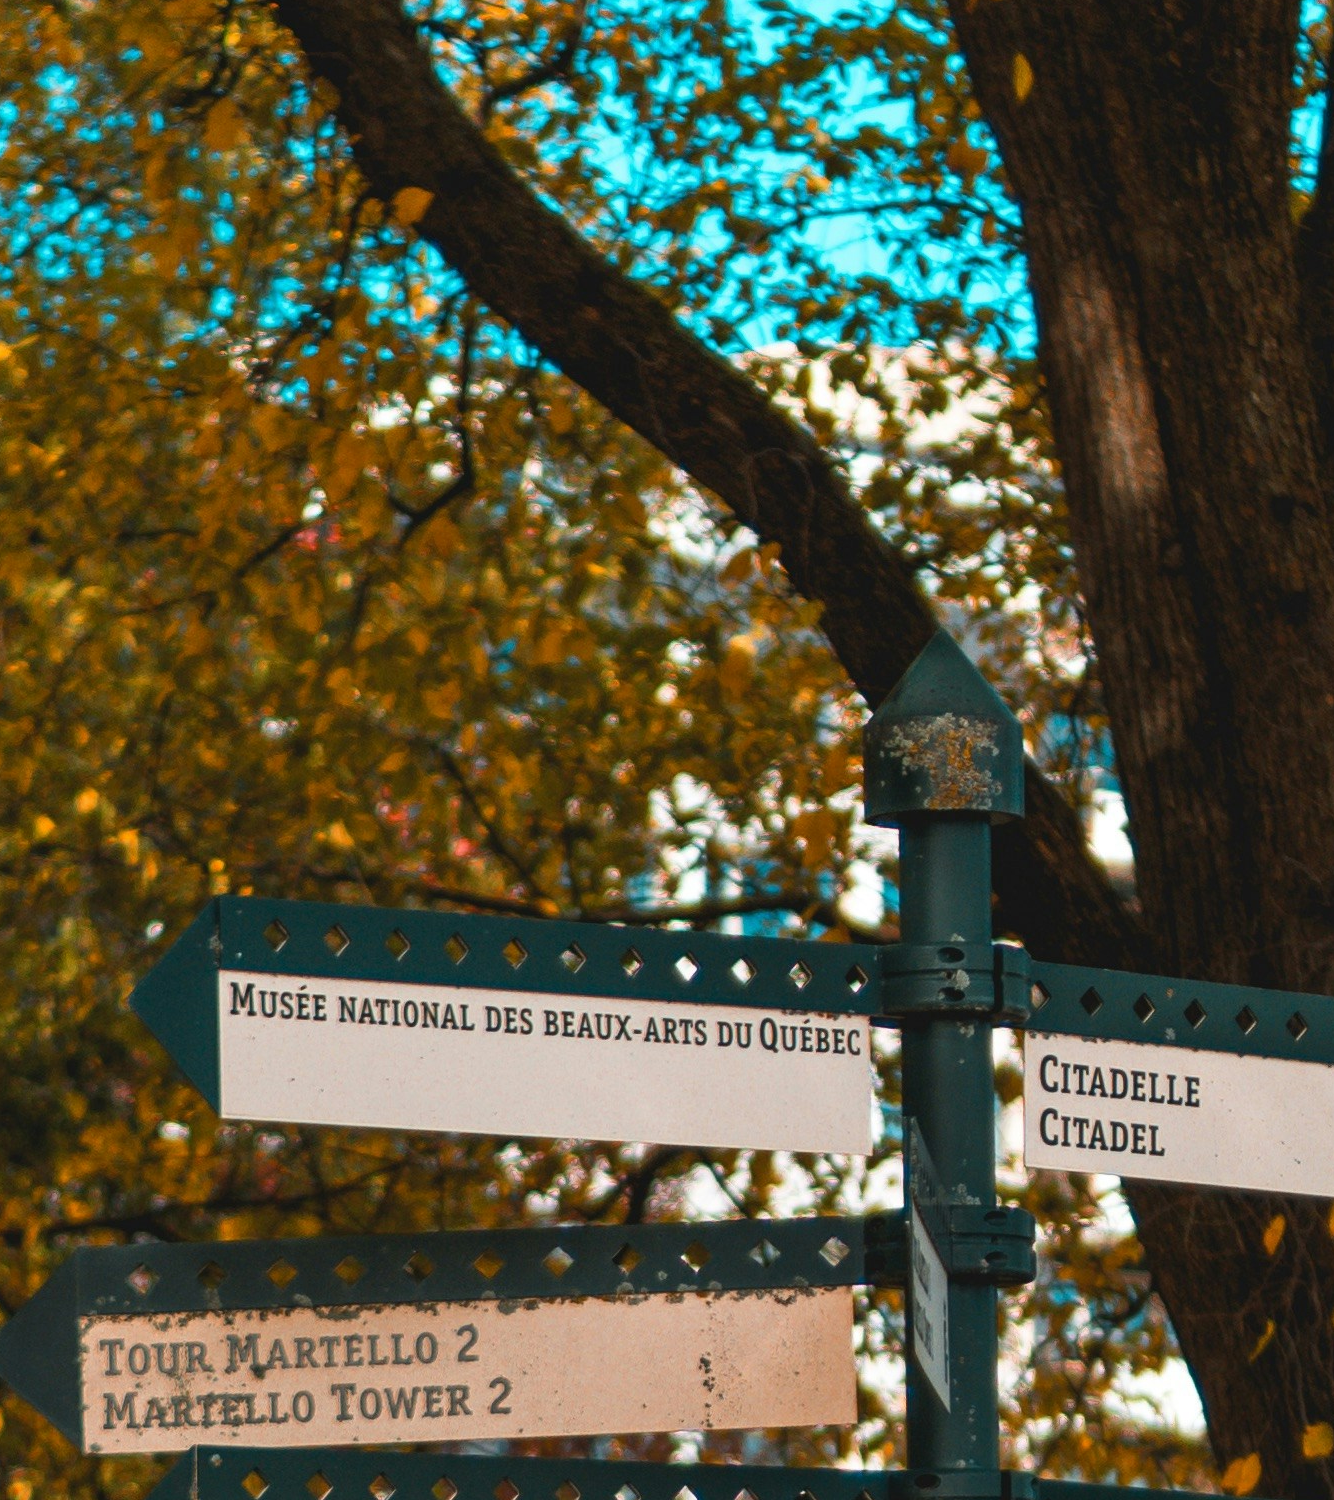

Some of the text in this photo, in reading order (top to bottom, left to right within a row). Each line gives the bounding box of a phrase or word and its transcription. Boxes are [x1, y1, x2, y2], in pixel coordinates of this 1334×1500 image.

[230, 982, 861, 1055] MUSÉE NATIONAL DES BEAUX-ARTS DU QUÉBEC
[1039, 1054, 1201, 1108] CITADELLE
[1039, 1108, 1166, 1157] CITADEL
[100, 1323, 480, 1377] TOUR MARTELLO 2
[102, 1376, 513, 1430] MARTELLO TOWER 2
